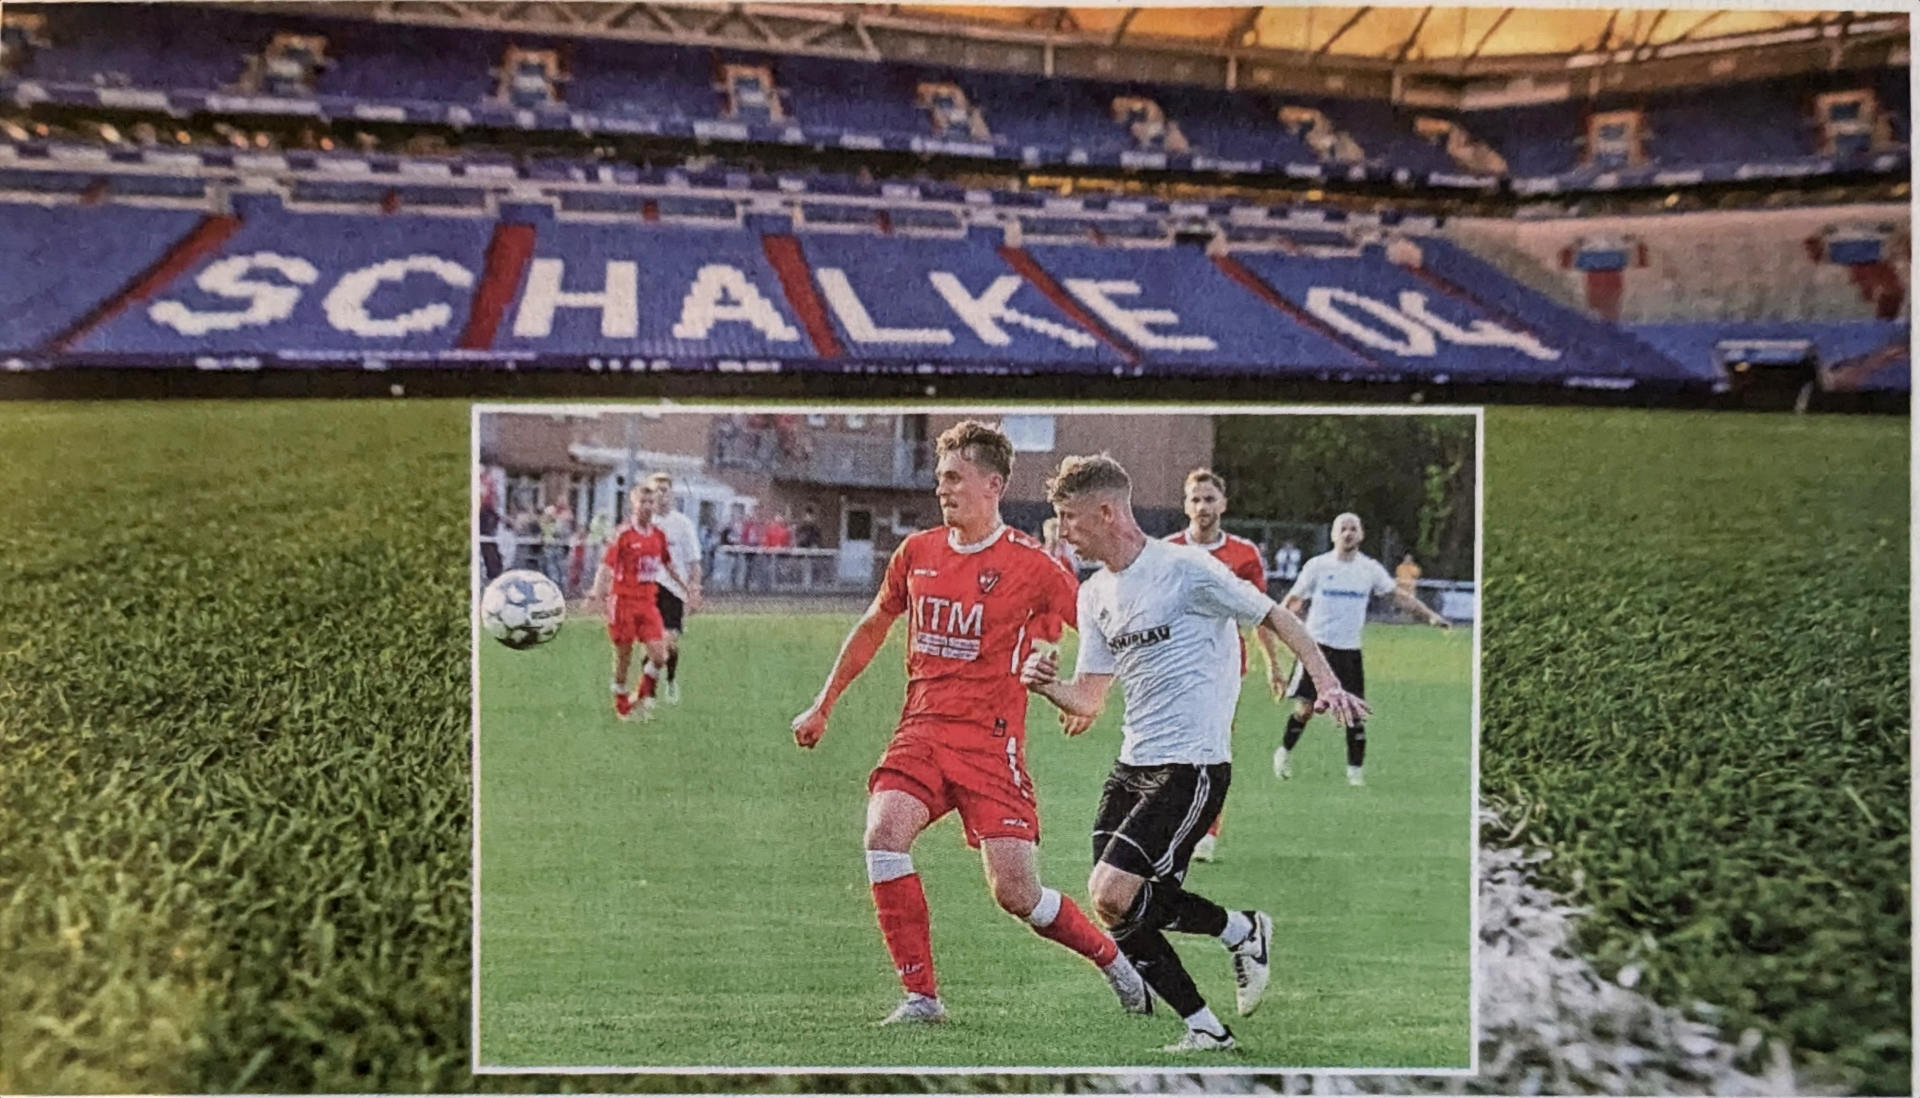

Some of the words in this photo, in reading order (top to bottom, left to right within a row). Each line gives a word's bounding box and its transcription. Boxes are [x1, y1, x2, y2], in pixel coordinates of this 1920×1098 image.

[149, 253, 1215, 351] SCHALKE
[1306, 286, 1560, 360] 04
[917, 595, 984, 637] ITM
